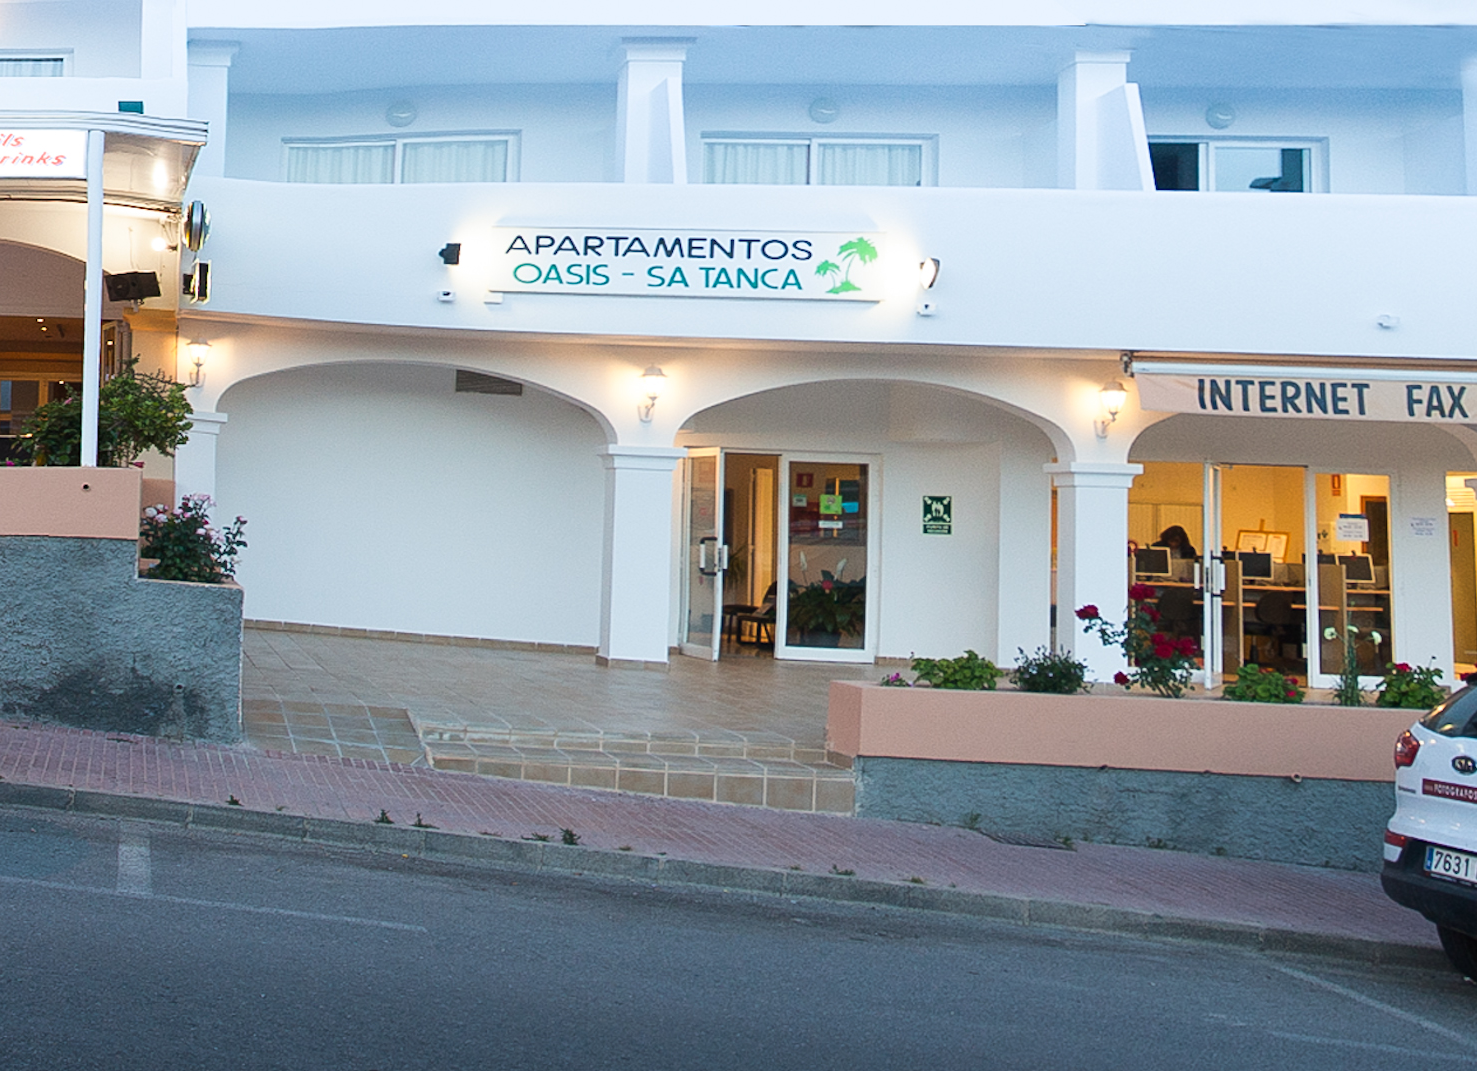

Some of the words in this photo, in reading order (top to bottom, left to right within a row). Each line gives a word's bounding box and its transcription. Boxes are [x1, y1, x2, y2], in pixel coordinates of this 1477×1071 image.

[506, 234, 814, 261] APARTAMENTOS
[513, 263, 611, 286] OASIS
[647, 265, 690, 288] SA
[699, 267, 803, 290] TANCA
[1198, 379, 1370, 416] INTERNET
[1406, 384, 1469, 419] FAX
[1433, 850, 1471, 878] 7631
